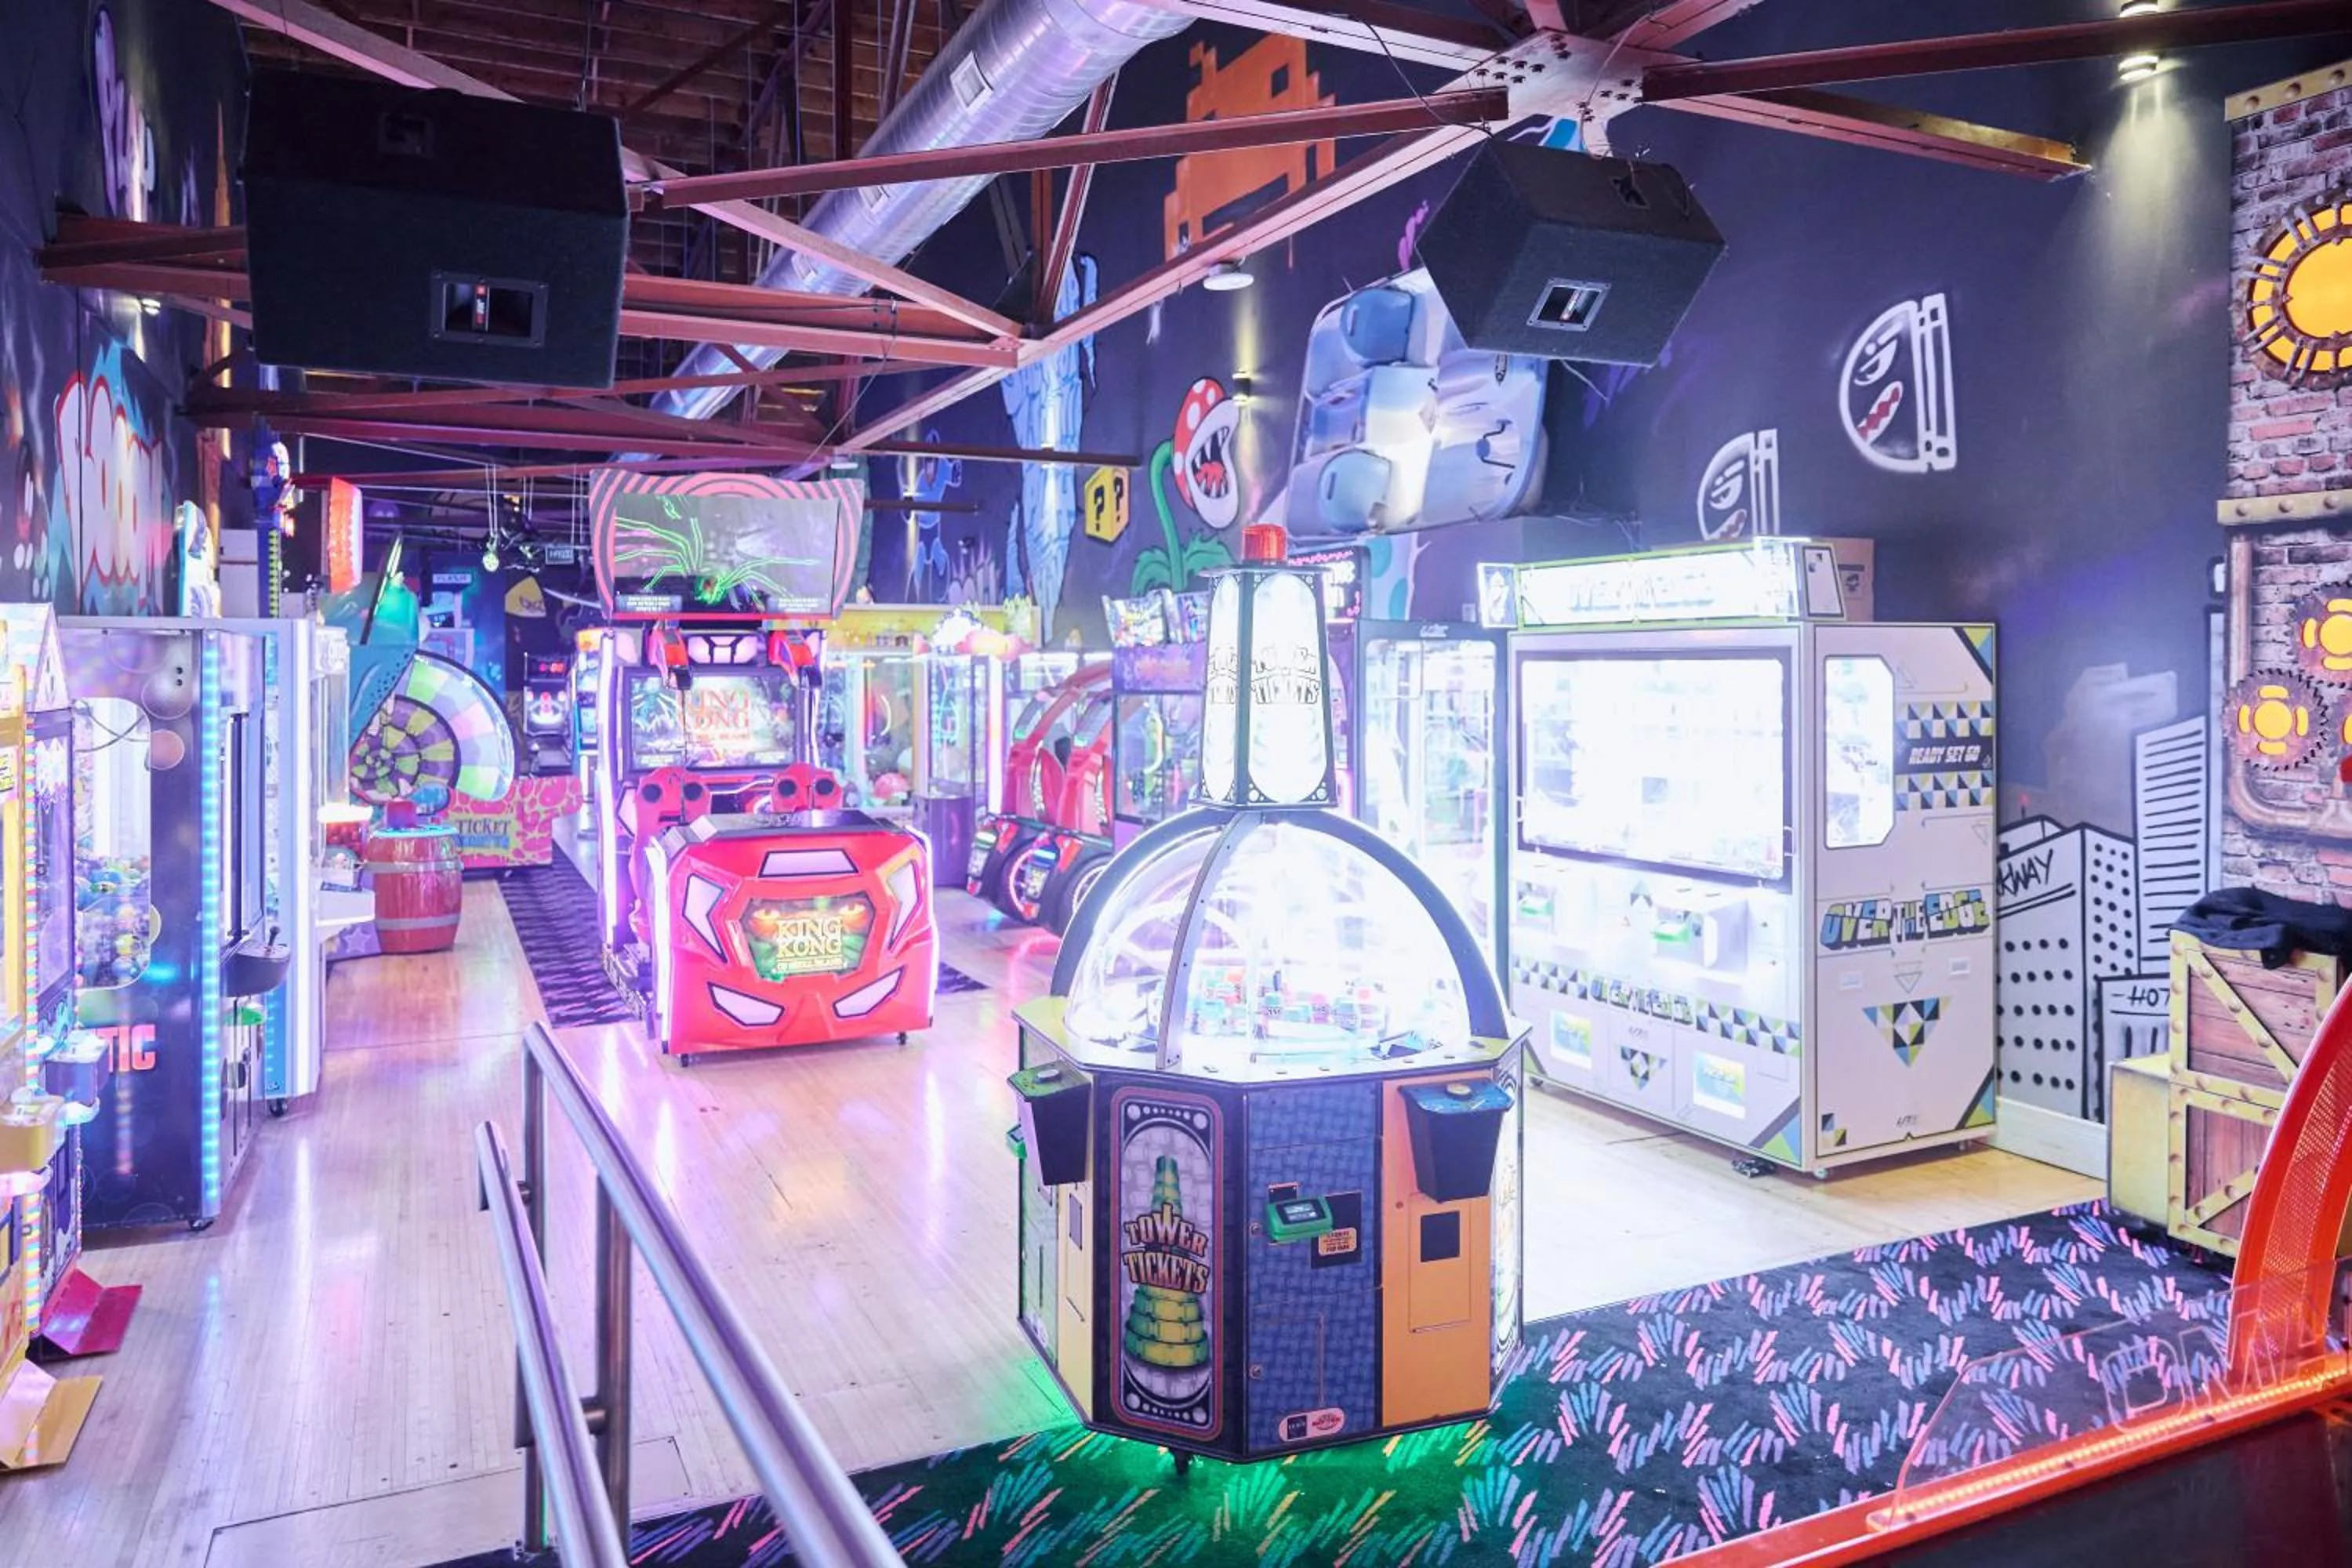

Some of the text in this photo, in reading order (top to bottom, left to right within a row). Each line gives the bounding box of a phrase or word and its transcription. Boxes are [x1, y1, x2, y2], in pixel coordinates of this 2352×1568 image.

[1908, 746, 1944, 765] READY
[455, 818, 511, 835] TICKET
[777, 916, 843, 940] KING
[1820, 888, 1991, 951] OVER THE EDGE
[777, 938, 842, 958] KONG
[89, 1024, 156, 1073] TIC
[1123, 1203, 1208, 1258] TOWER
[1122, 1250, 1210, 1294] TICKETS
